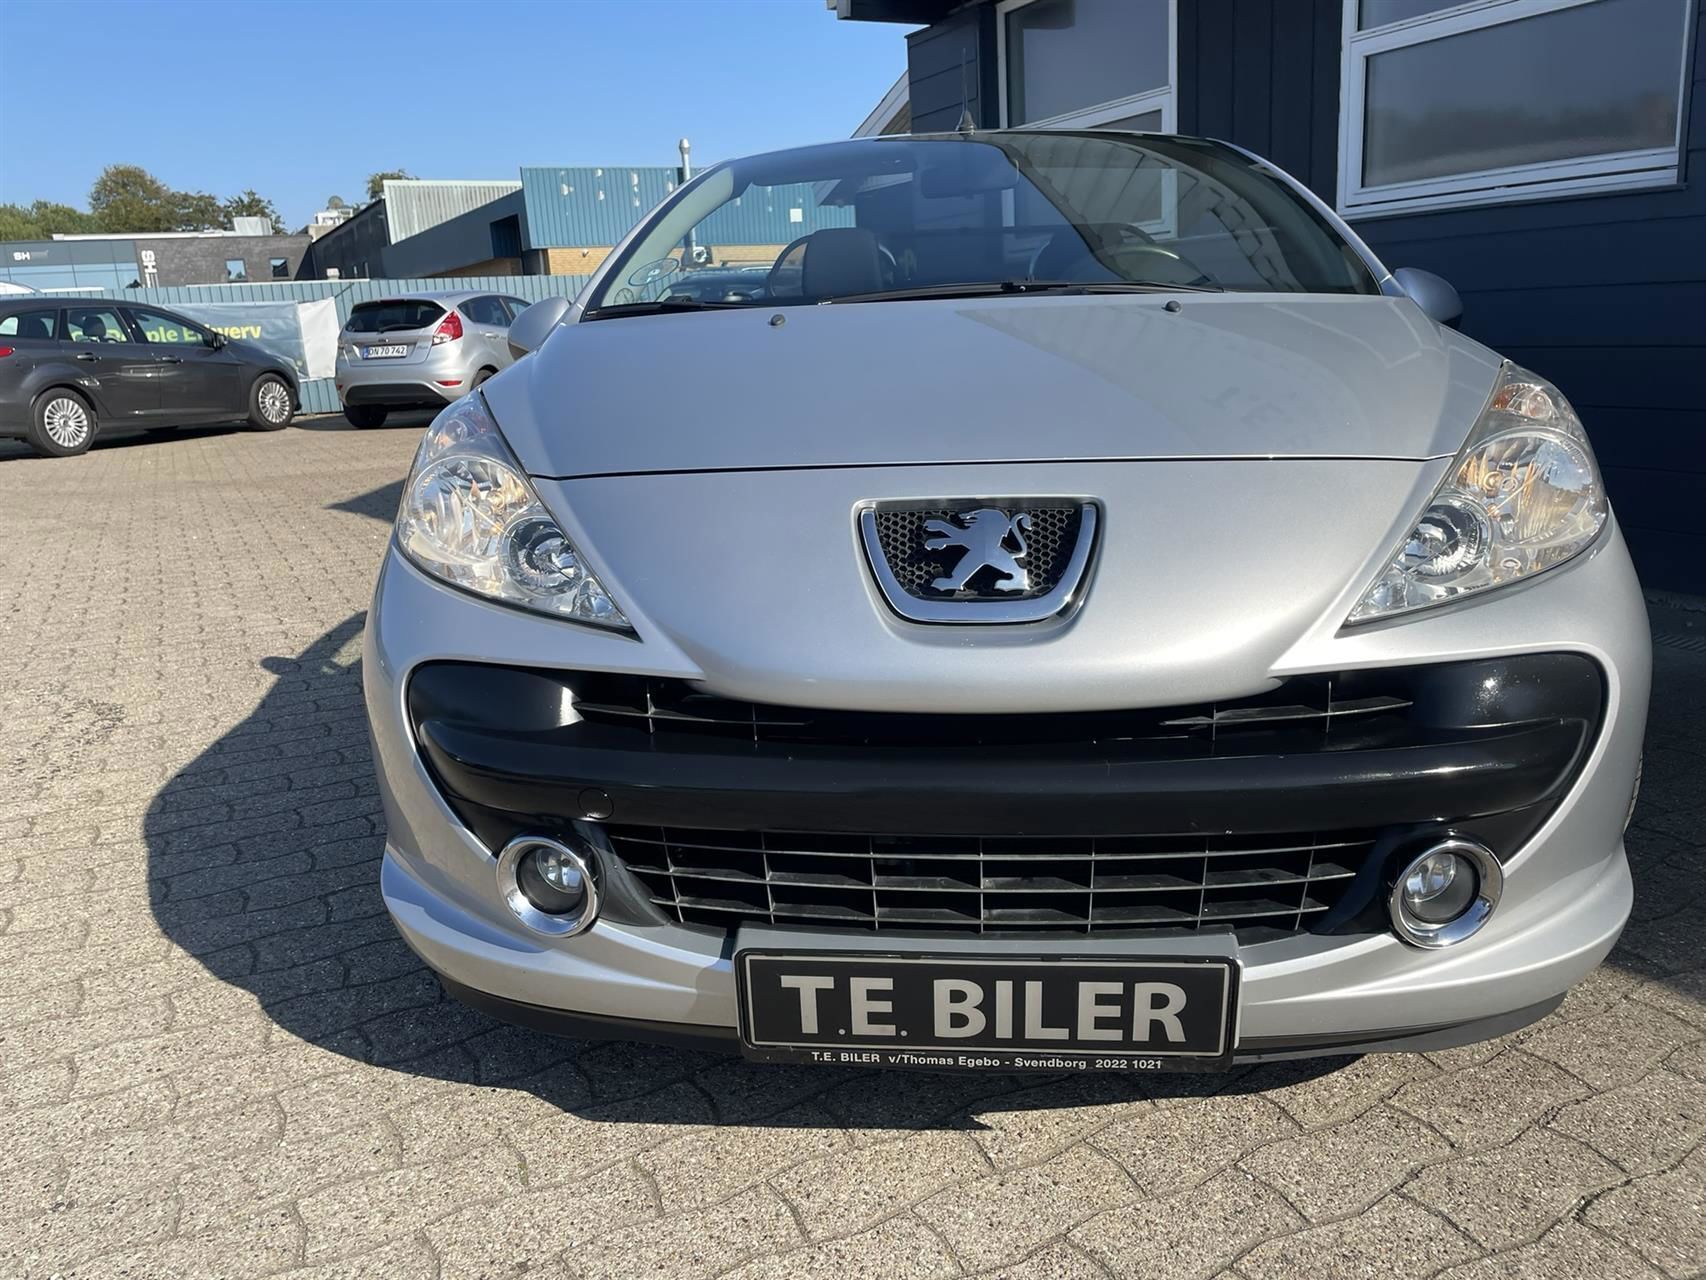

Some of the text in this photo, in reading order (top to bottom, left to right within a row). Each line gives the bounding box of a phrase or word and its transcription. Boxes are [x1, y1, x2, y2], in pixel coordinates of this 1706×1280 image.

[13, 251, 31, 261] SH
[781, 974, 1188, 1043] T.E. BILER
[811, 1051, 836, 1062] T.E.
[840, 1052, 880, 1063] BILER
[888, 1053, 954, 1066] v/Thomas
[958, 1056, 1000, 1068] Egebo
[1014, 1057, 1087, 1070] Svendborg
[1095, 1059, 1128, 1069] 2022
[1132, 1060, 1162, 1070] 1021
